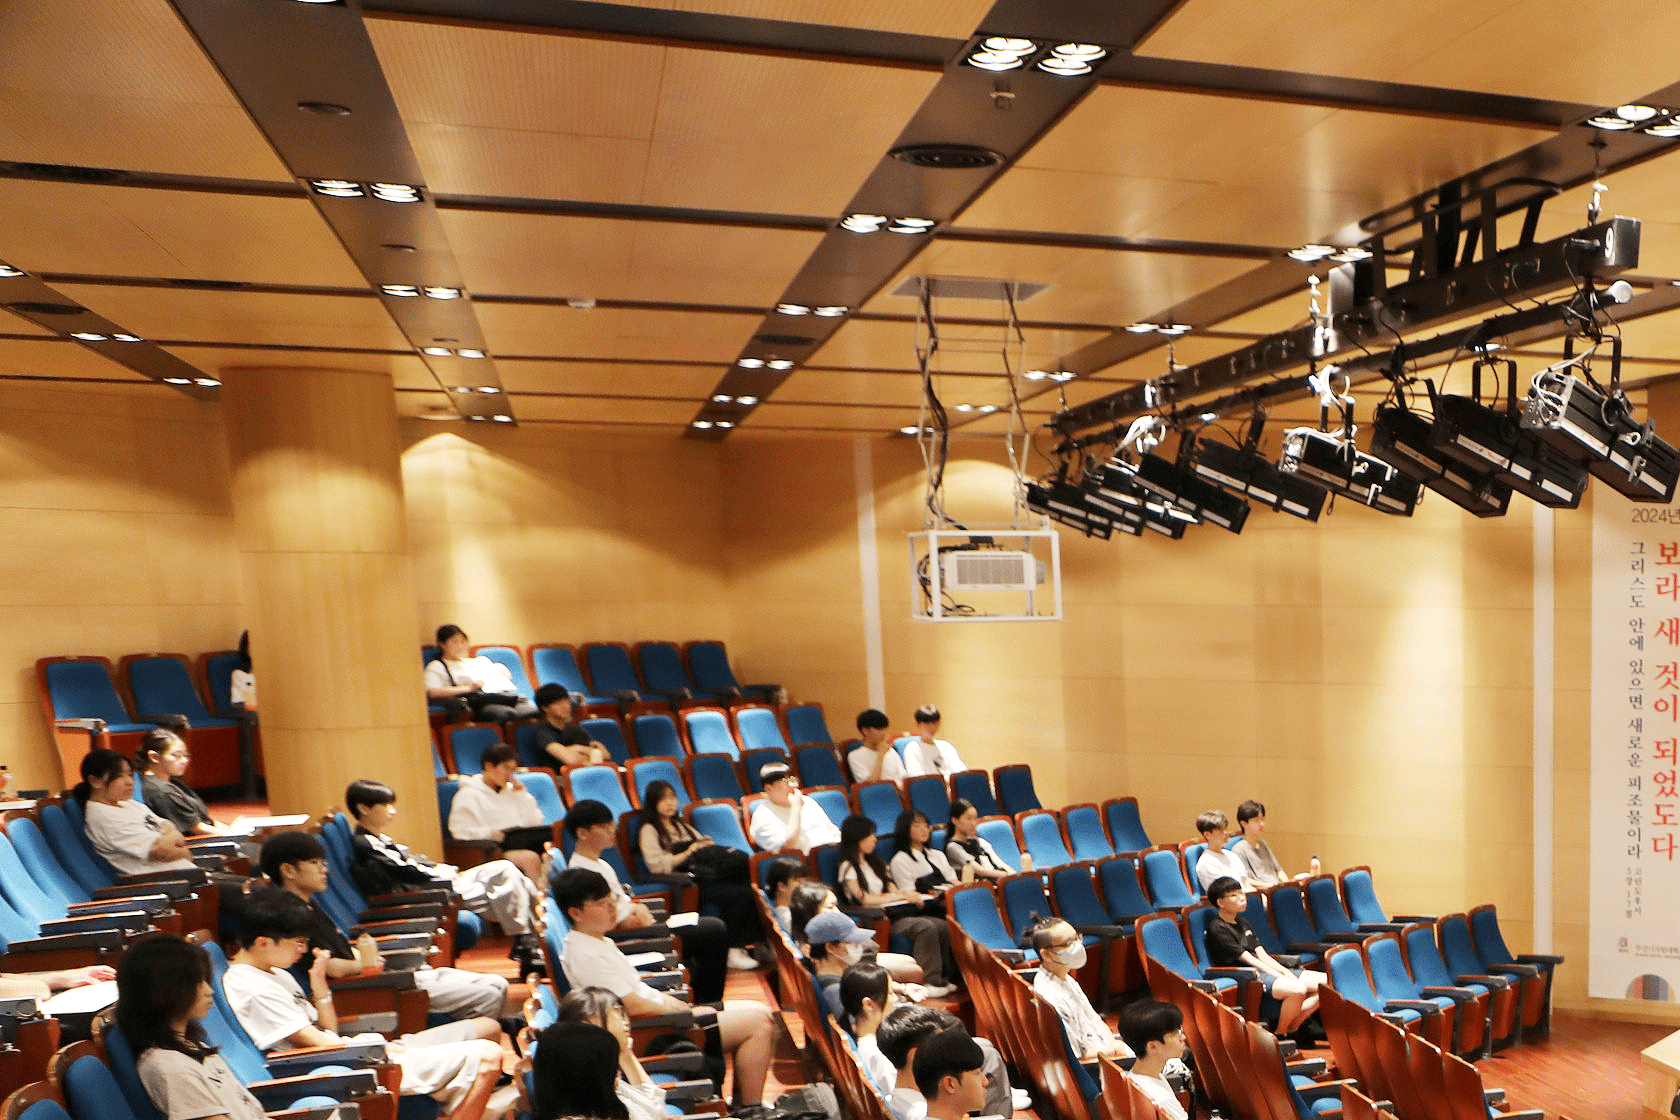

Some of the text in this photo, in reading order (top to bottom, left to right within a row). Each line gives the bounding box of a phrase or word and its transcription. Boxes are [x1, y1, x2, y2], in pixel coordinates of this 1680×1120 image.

[1605, 227, 1615, 258] 9
[1654, 617, 1680, 646] 새
[1627, 541, 1646, 860] 그리스도 안에 있으면 새로운 피조물이라
[1654, 661, 1680, 722] 것이
[1651, 737, 1679, 861] 되었도다
